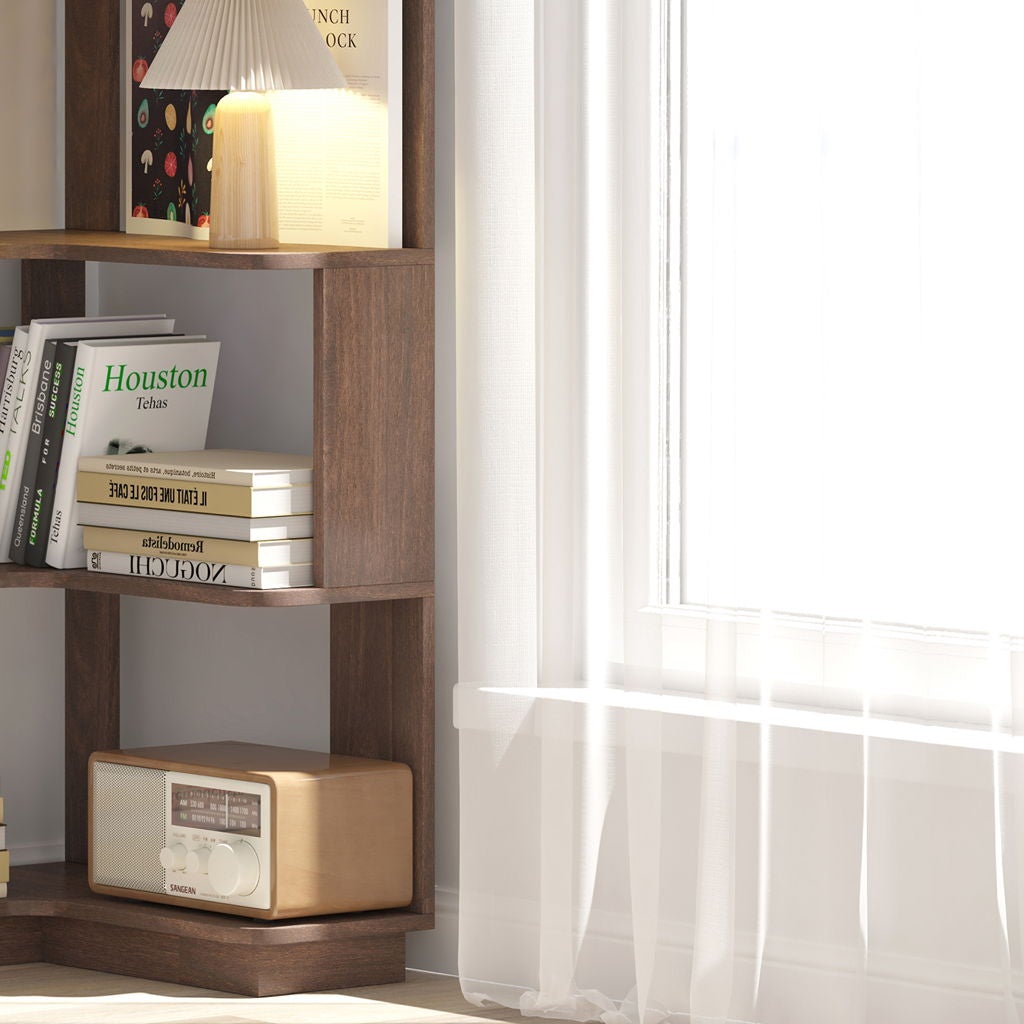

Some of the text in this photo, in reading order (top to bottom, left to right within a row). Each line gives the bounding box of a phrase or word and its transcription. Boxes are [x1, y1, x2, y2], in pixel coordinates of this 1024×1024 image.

[0, 351, 31, 492] TED TALKS
[102, 364, 207, 392] Houston
[136, 396, 168, 410] Tehas
[14, 360, 52, 547] Queensland Brisbane
[29, 362, 62, 546] FORMULA FOR SUCCESS
[50, 367, 85, 544] Tehas Houston
[170, 884, 196, 894] SANGEAN
